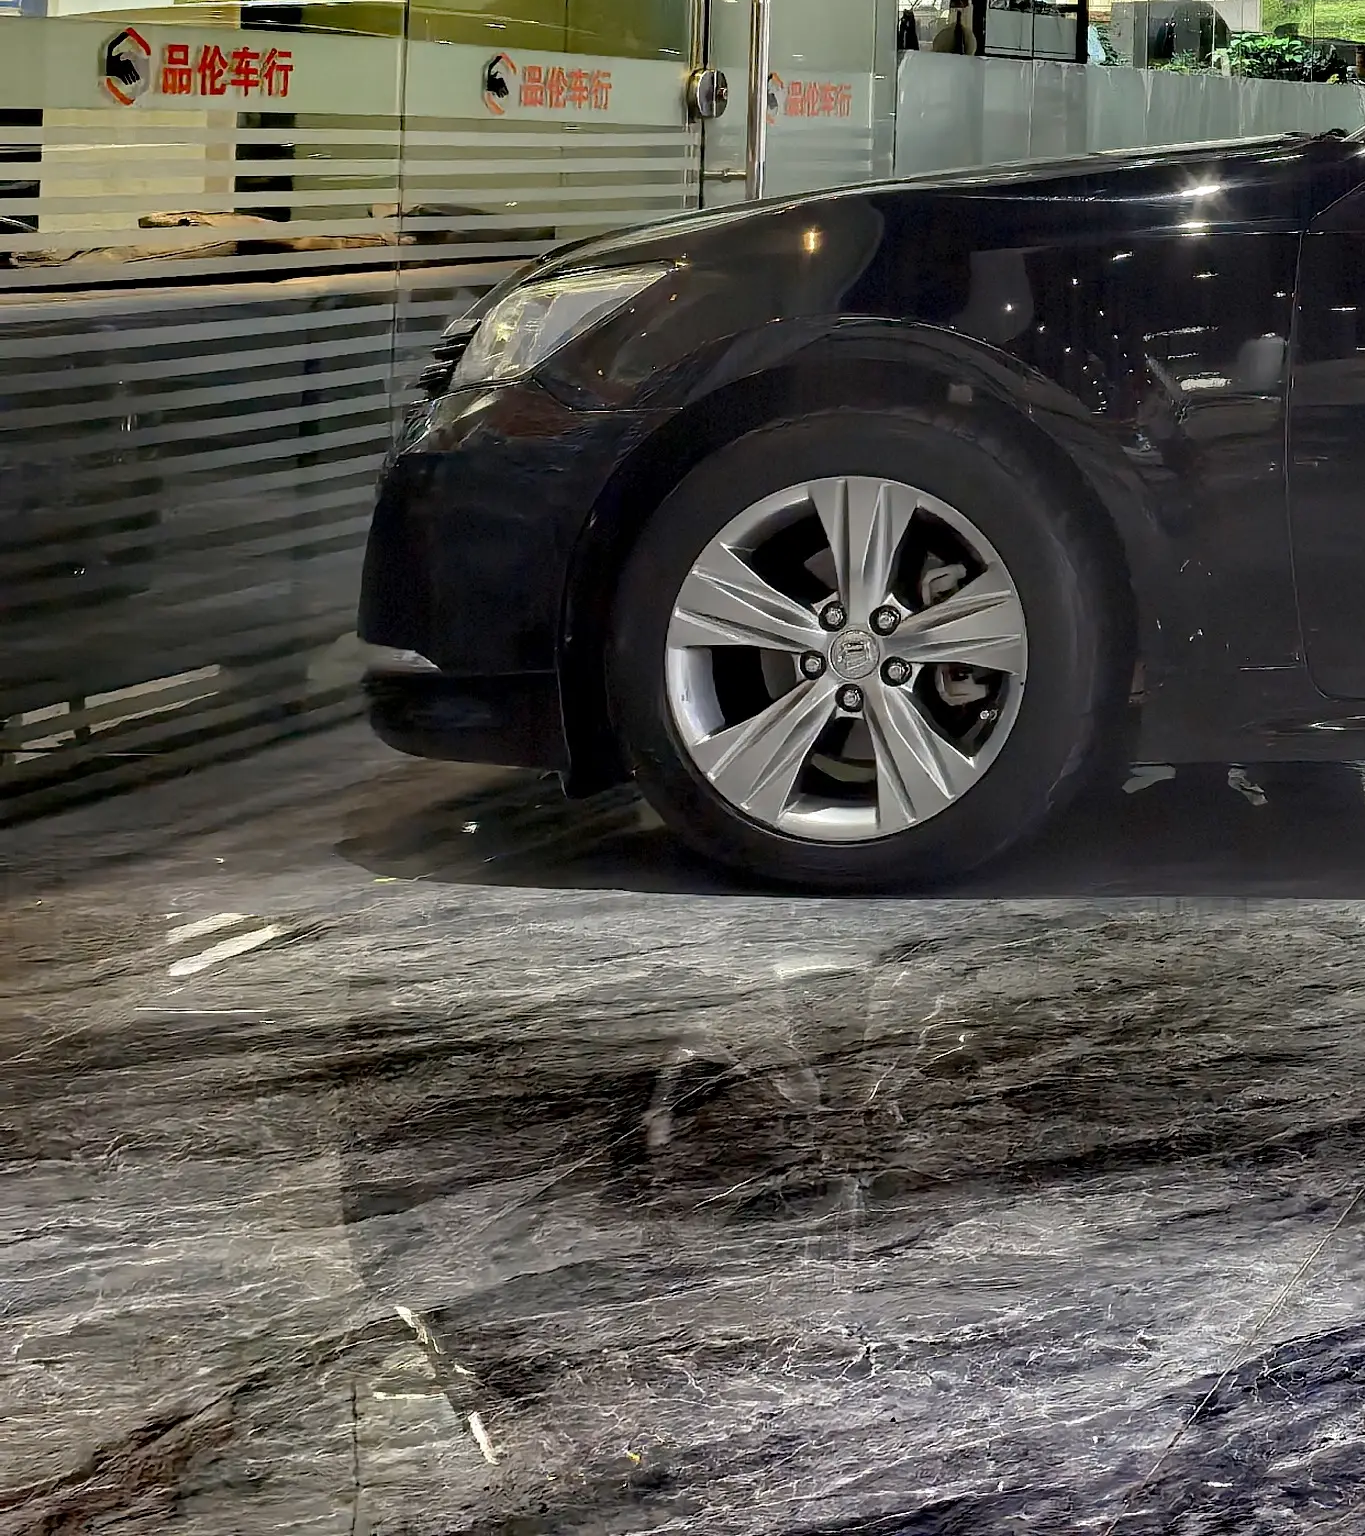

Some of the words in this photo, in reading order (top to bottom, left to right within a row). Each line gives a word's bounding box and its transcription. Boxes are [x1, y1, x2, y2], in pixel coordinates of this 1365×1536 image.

[161, 44, 294, 97] 品伦车行
[519, 65, 613, 111] 品伦车行
[784, 81, 852, 118] 品伦车行
